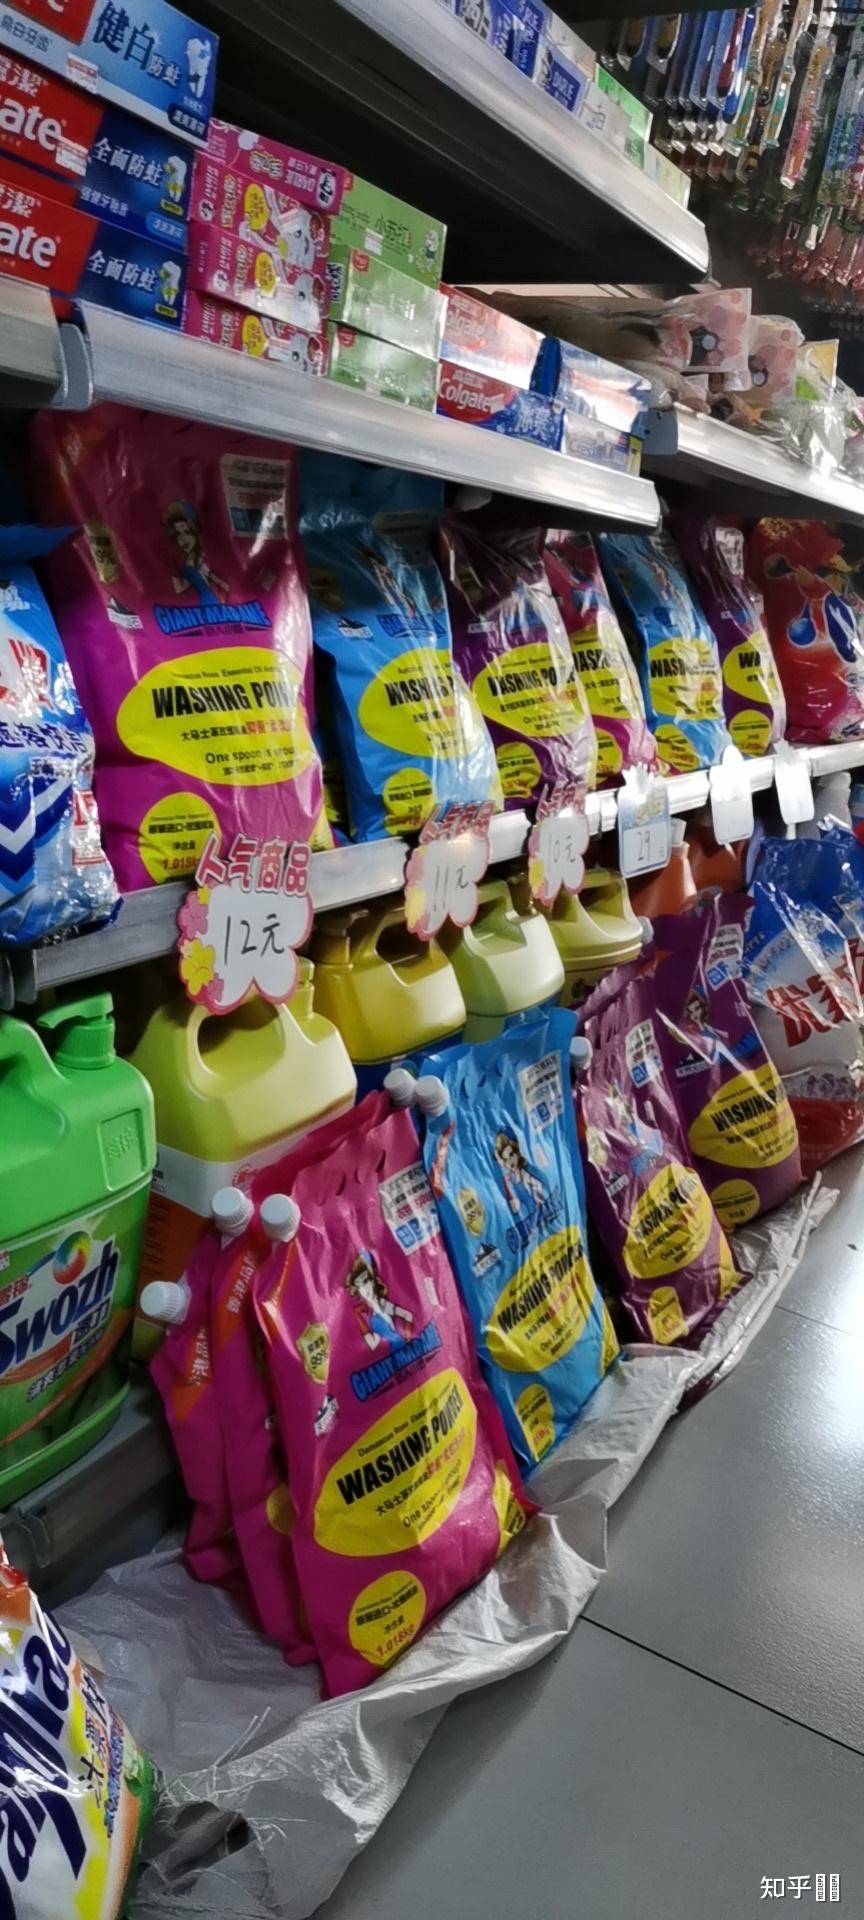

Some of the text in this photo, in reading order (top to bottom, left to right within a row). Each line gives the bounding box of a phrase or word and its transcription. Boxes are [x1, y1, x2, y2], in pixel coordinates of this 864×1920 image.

[92, 137, 163, 188] 全面防蛀
[86, 249, 158, 292] 全面防蛀
[438, 378, 491, 413] Colgate
[152, 683, 252, 719] WASHING
[195, 832, 313, 898] 人气商品
[223, 912, 286, 967] 12元
[351, 1353, 397, 1403] GIANT
[336, 1427, 432, 1505] WASHING
